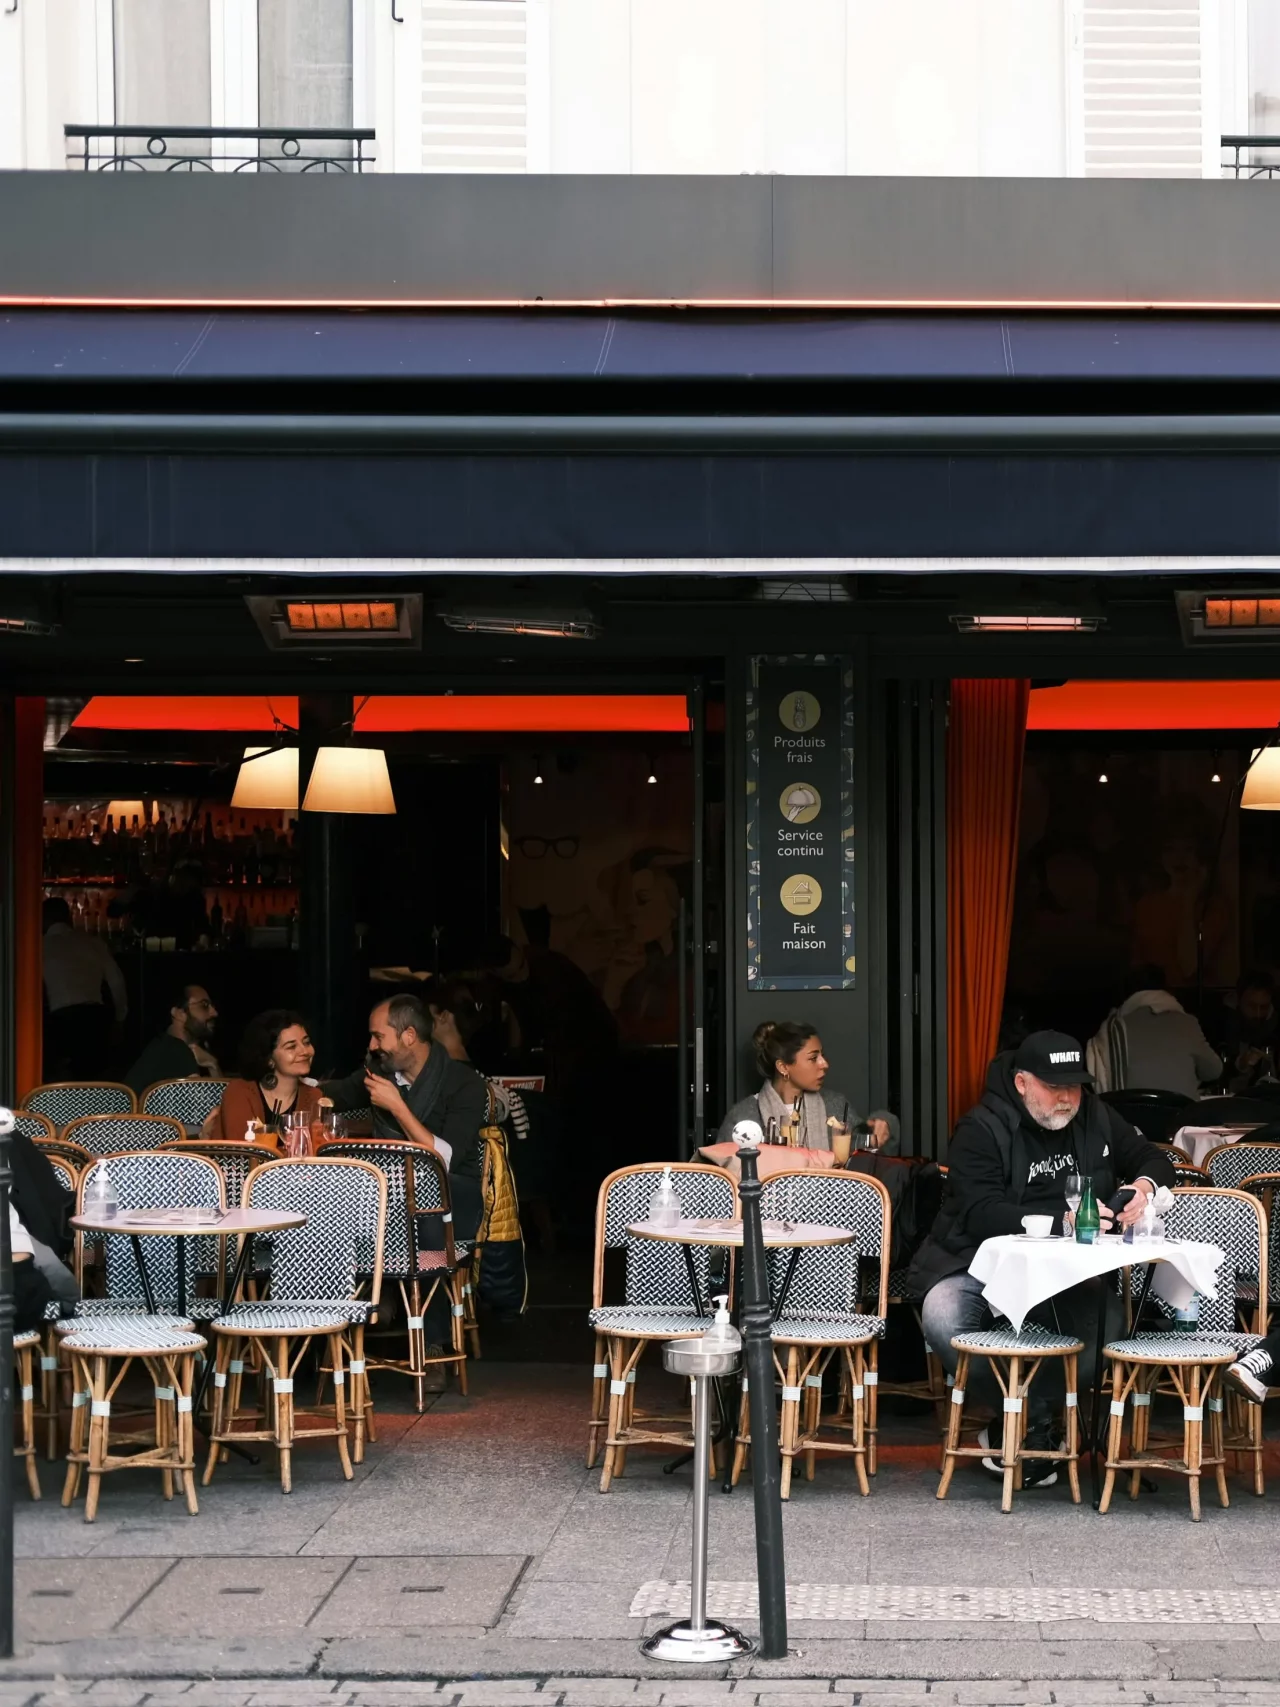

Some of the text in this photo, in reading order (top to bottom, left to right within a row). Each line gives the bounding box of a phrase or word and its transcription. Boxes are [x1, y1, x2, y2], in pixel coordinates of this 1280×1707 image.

[774, 736, 826, 748] Produits
[787, 751, 813, 763] frais
[778, 829, 823, 841] Service
[777, 844, 824, 856] continu
[794, 922, 816, 934] Fait
[782, 938, 826, 949] maison
